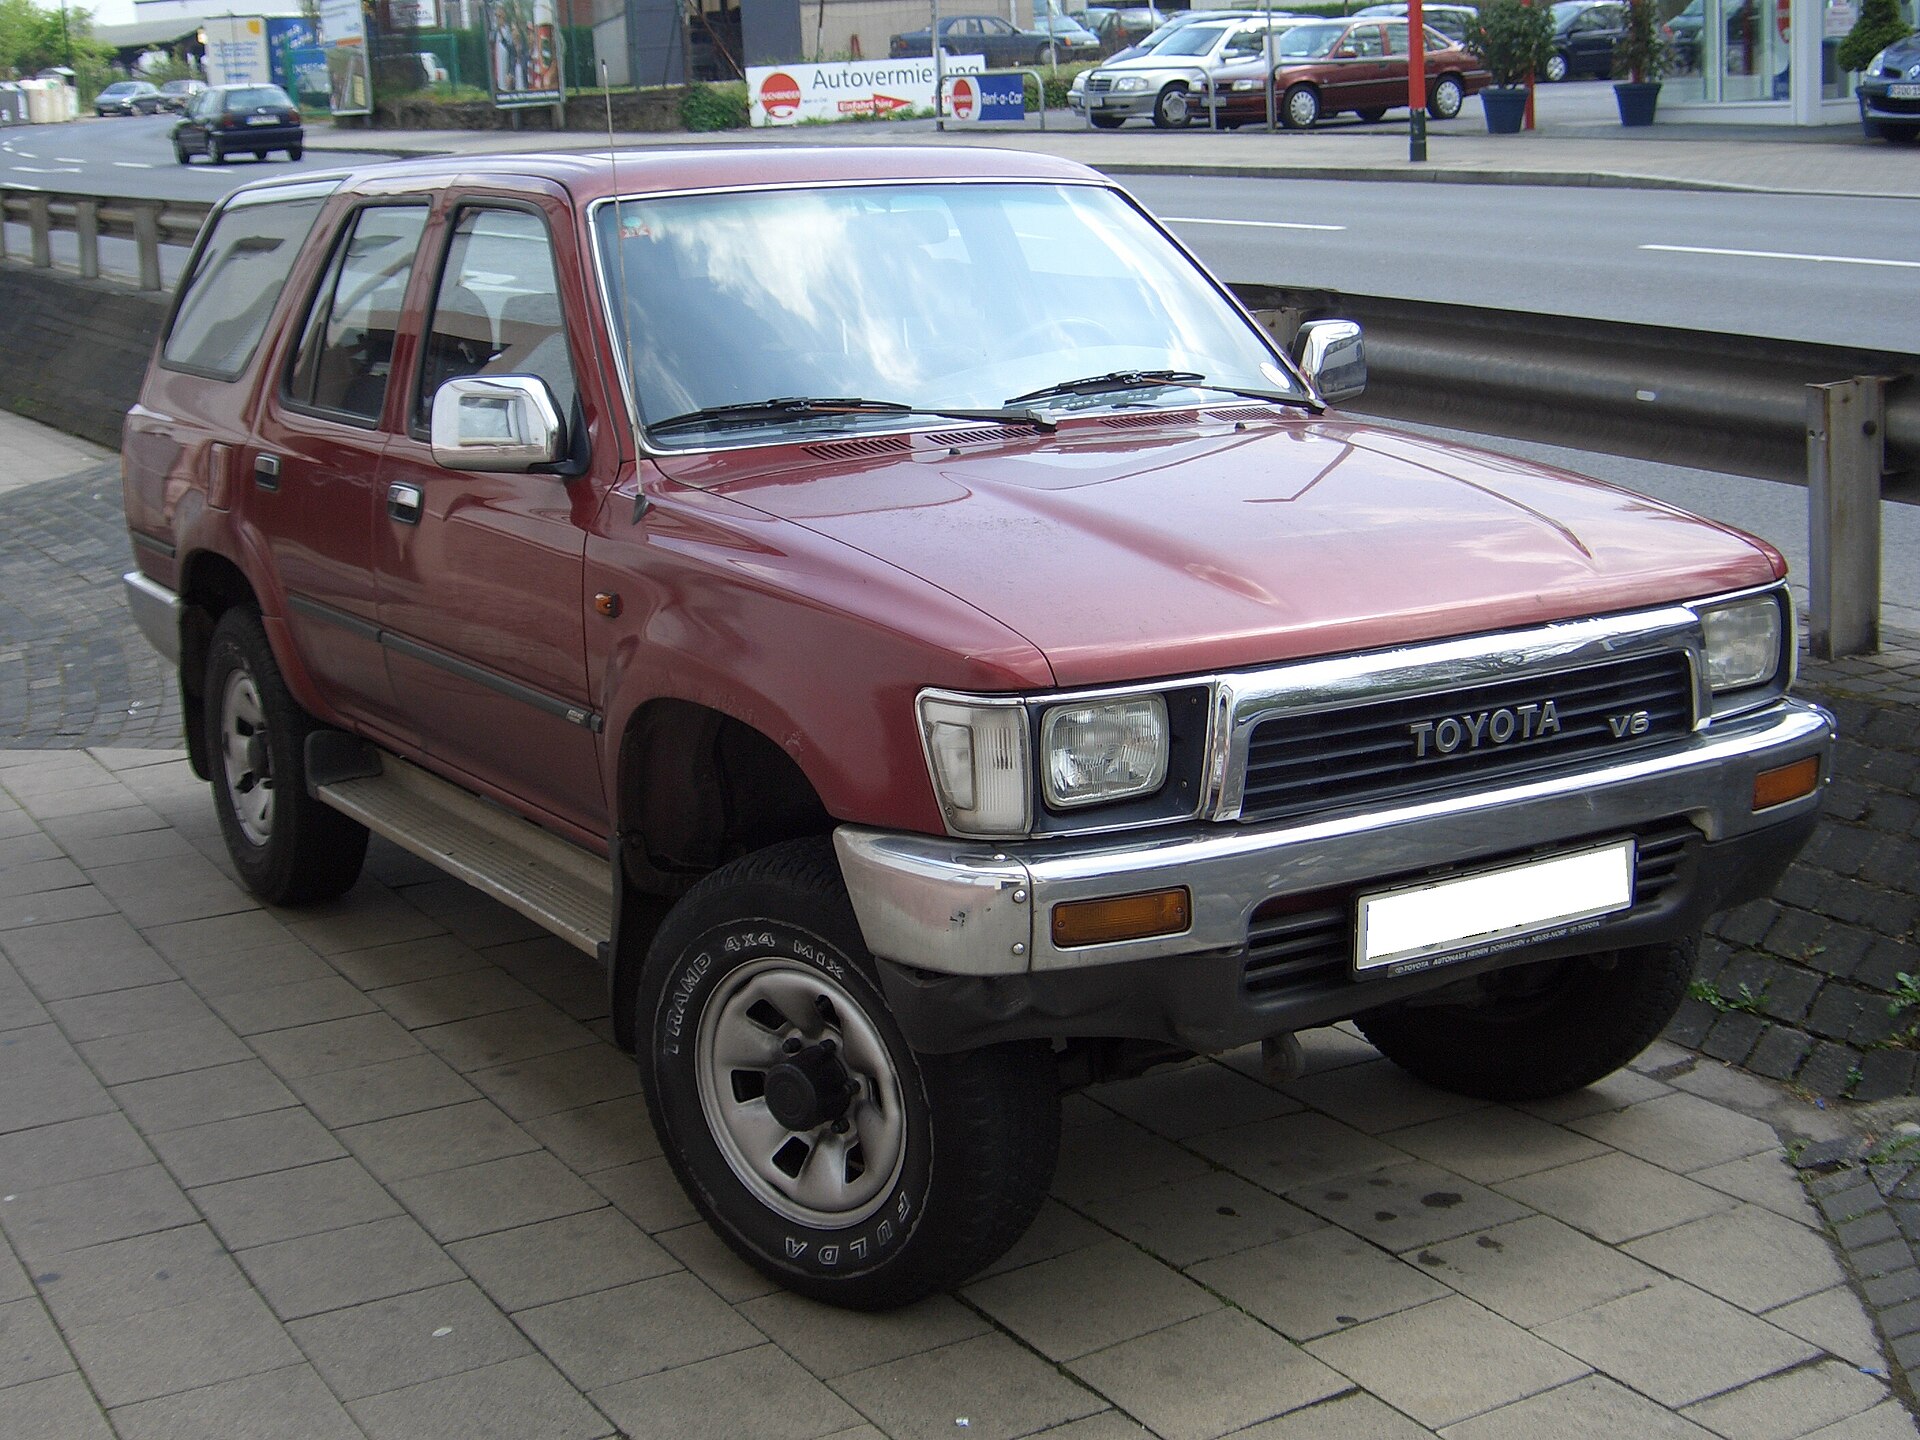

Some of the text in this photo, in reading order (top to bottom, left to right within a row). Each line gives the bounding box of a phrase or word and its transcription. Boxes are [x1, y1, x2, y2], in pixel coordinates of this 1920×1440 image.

[812, 62, 979, 89] Autovermie
[1410, 700, 1649, 757] TOYOTA V6
[1404, 961, 1429, 972] TOYOTA
[663, 952, 712, 1055] TRAMP
[793, 940, 844, 980] MIX
[785, 1190, 911, 1265] FULDA
